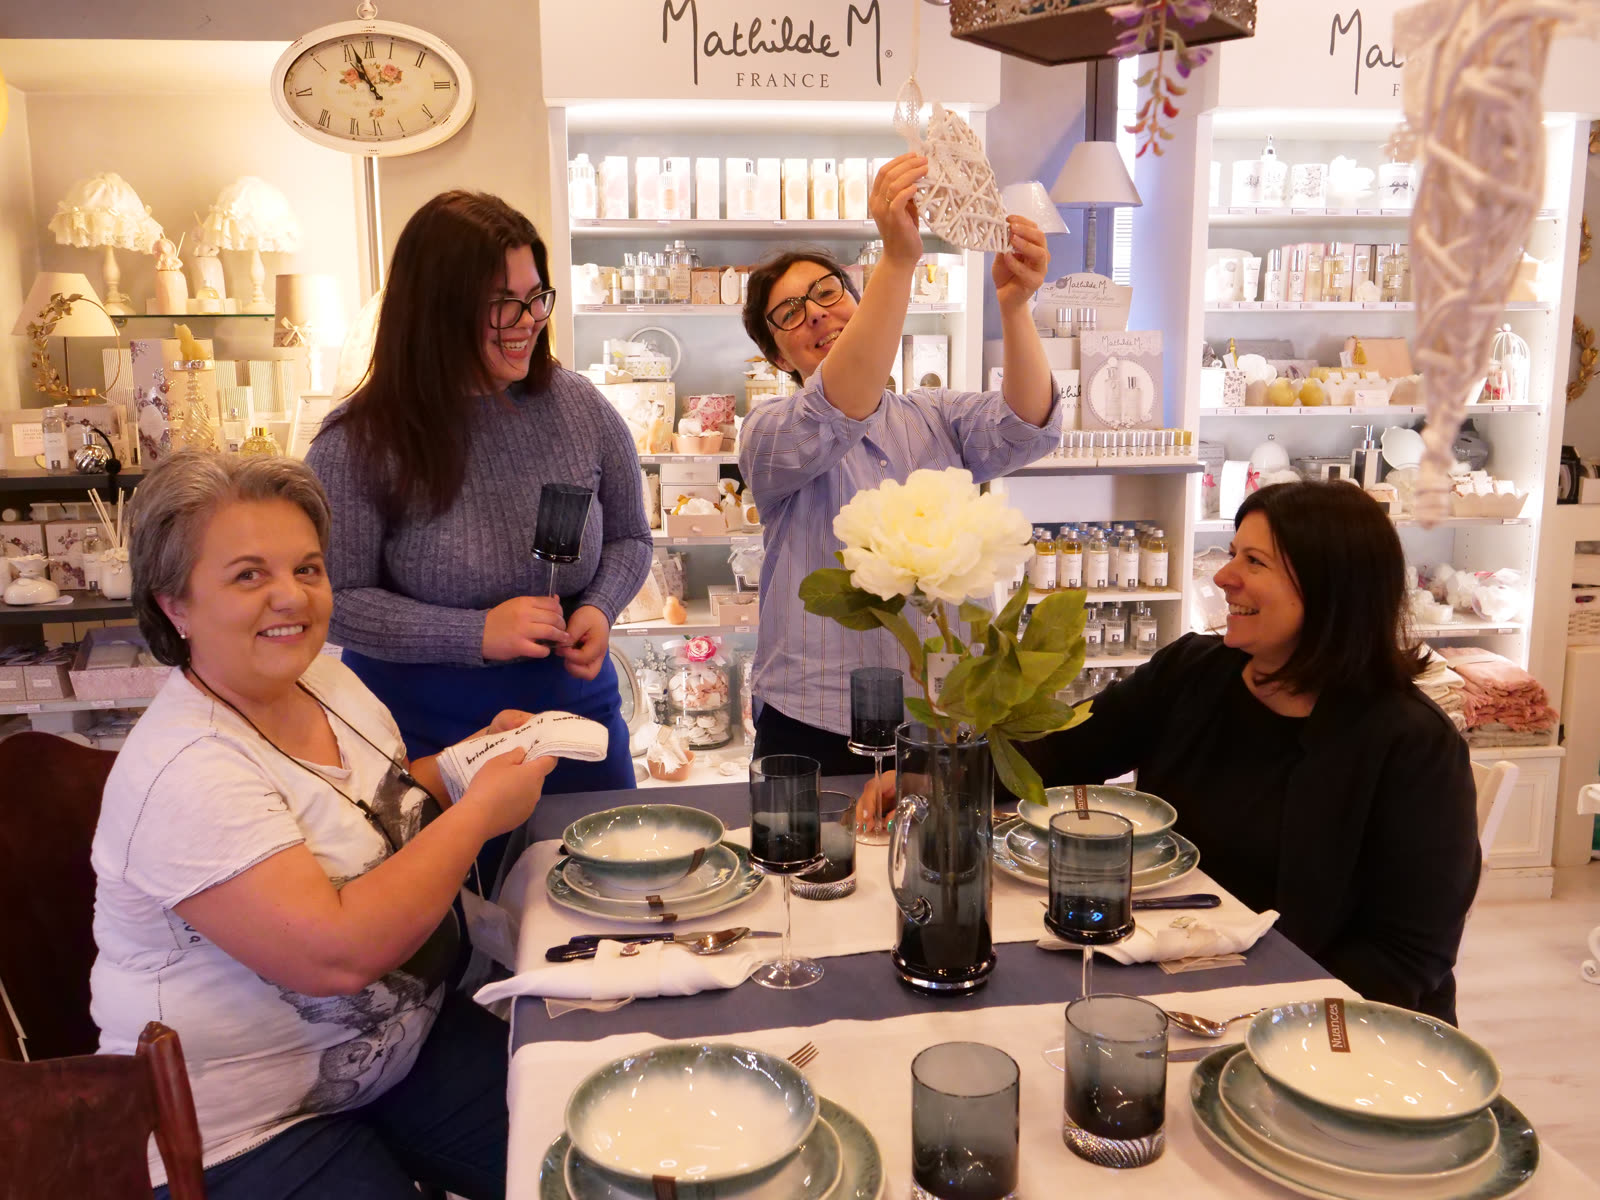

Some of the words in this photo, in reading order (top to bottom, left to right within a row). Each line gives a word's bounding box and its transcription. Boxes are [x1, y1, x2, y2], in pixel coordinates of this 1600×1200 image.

[662, 0, 840, 86] Mathilde
[736, 72, 830, 88] FRANCE
[465, 737, 508, 766] brindare
[1329, 1002, 1344, 1049] Nuances
